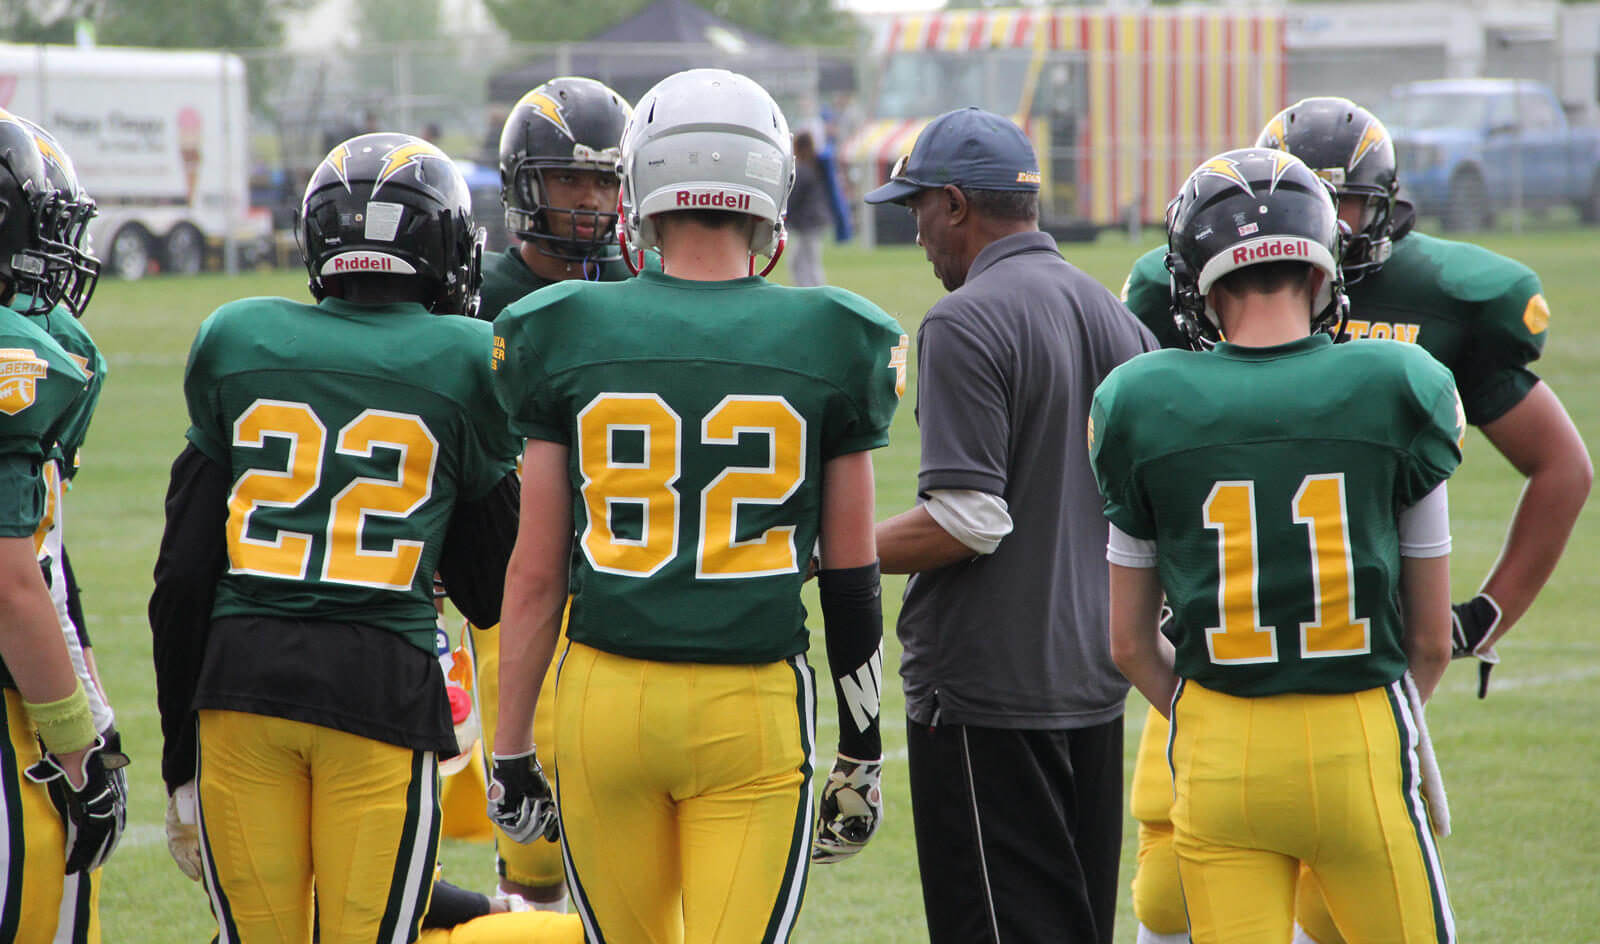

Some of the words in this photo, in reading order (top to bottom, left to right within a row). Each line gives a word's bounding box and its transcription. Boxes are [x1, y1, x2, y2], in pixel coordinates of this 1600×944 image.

[676, 190, 751, 209] Riddell
[334, 256, 392, 271] Riddell
[1233, 240, 1309, 264] Riddell
[1329, 319, 1420, 344] TON
[225, 398, 439, 591] 22
[576, 392, 807, 579] 82
[1202, 472, 1372, 666] 11
